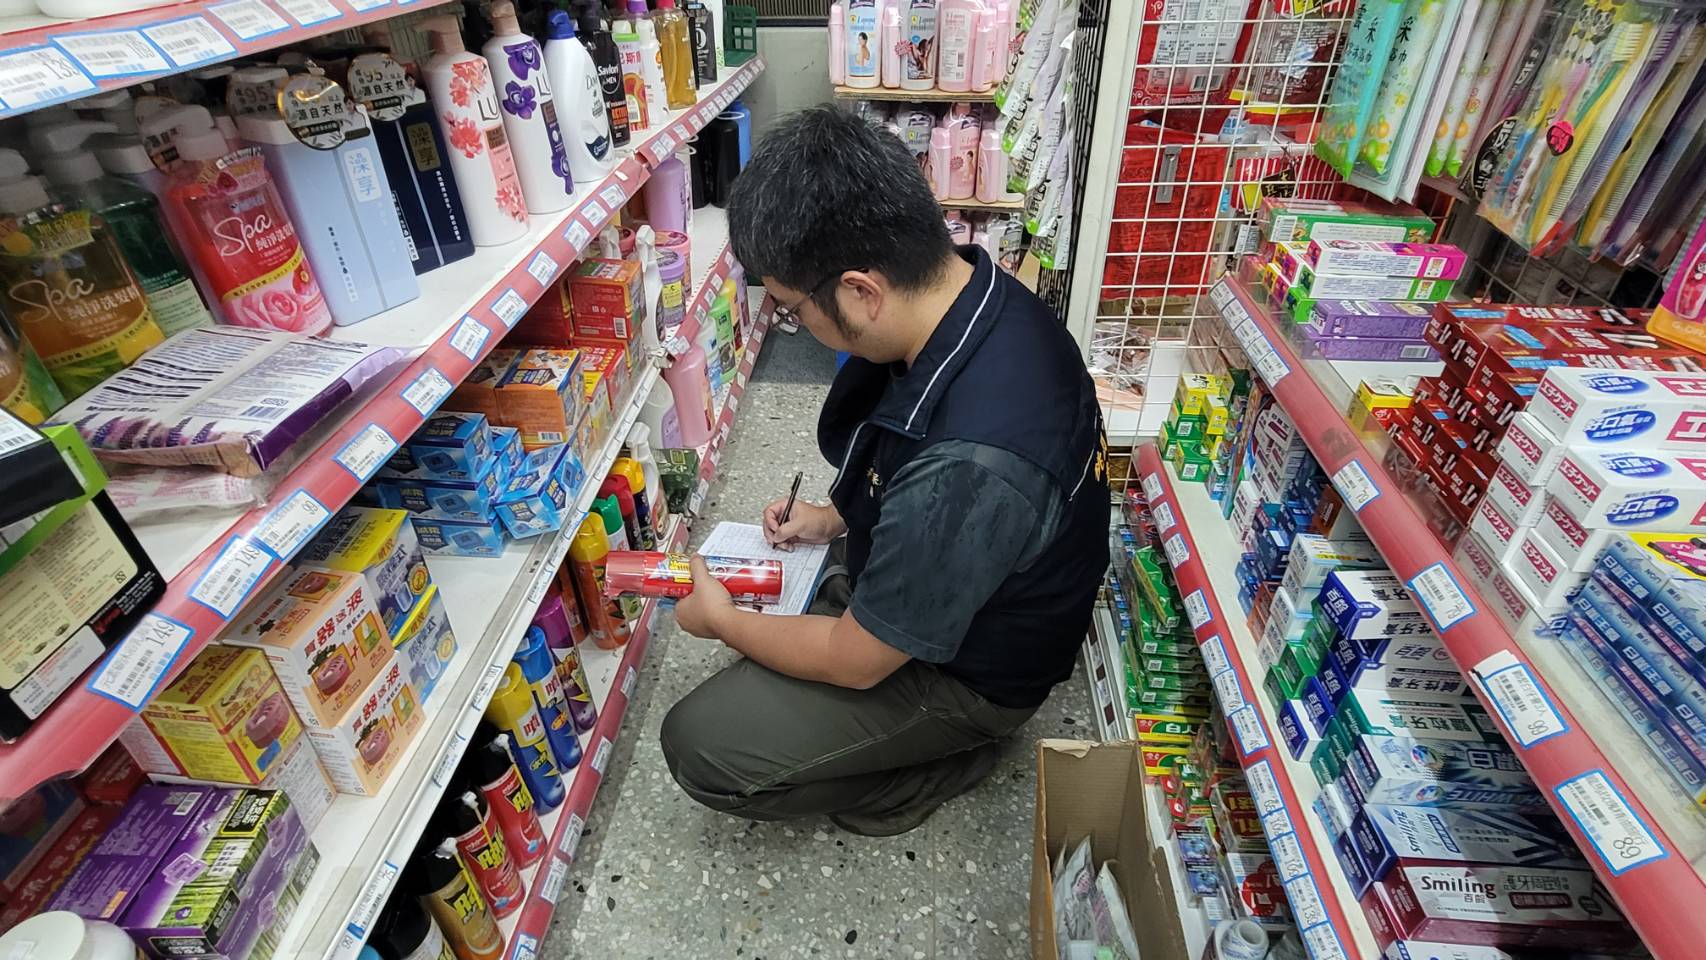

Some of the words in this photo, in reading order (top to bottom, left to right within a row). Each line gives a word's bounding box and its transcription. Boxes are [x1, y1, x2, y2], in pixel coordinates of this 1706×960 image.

[597, 65, 619, 77] Savlon
[363, 81, 405, 96] 源自天然
[298, 104, 344, 121] 源自天然
[213, 214, 272, 257] Spa
[9, 279, 94, 322] Spa
[1541, 380, 1577, 416] エチケット
[1509, 425, 1541, 462] エチケット
[1498, 466, 1531, 503] エチケット
[1560, 460, 1600, 501] エチケット
[1482, 503, 1514, 540] エチケット
[1549, 504, 1587, 544] エチケット
[235, 544, 261, 567] 149
[1523, 541, 1556, 580] エチケット
[1326, 588, 1349, 614] 百齡
[145, 620, 175, 648] 149
[1389, 714, 1473, 732] 鹽粒牙膏
[1527, 719, 1550, 736] 99
[1613, 836, 1642, 858] 89
[1421, 875, 1497, 899] Smiling
